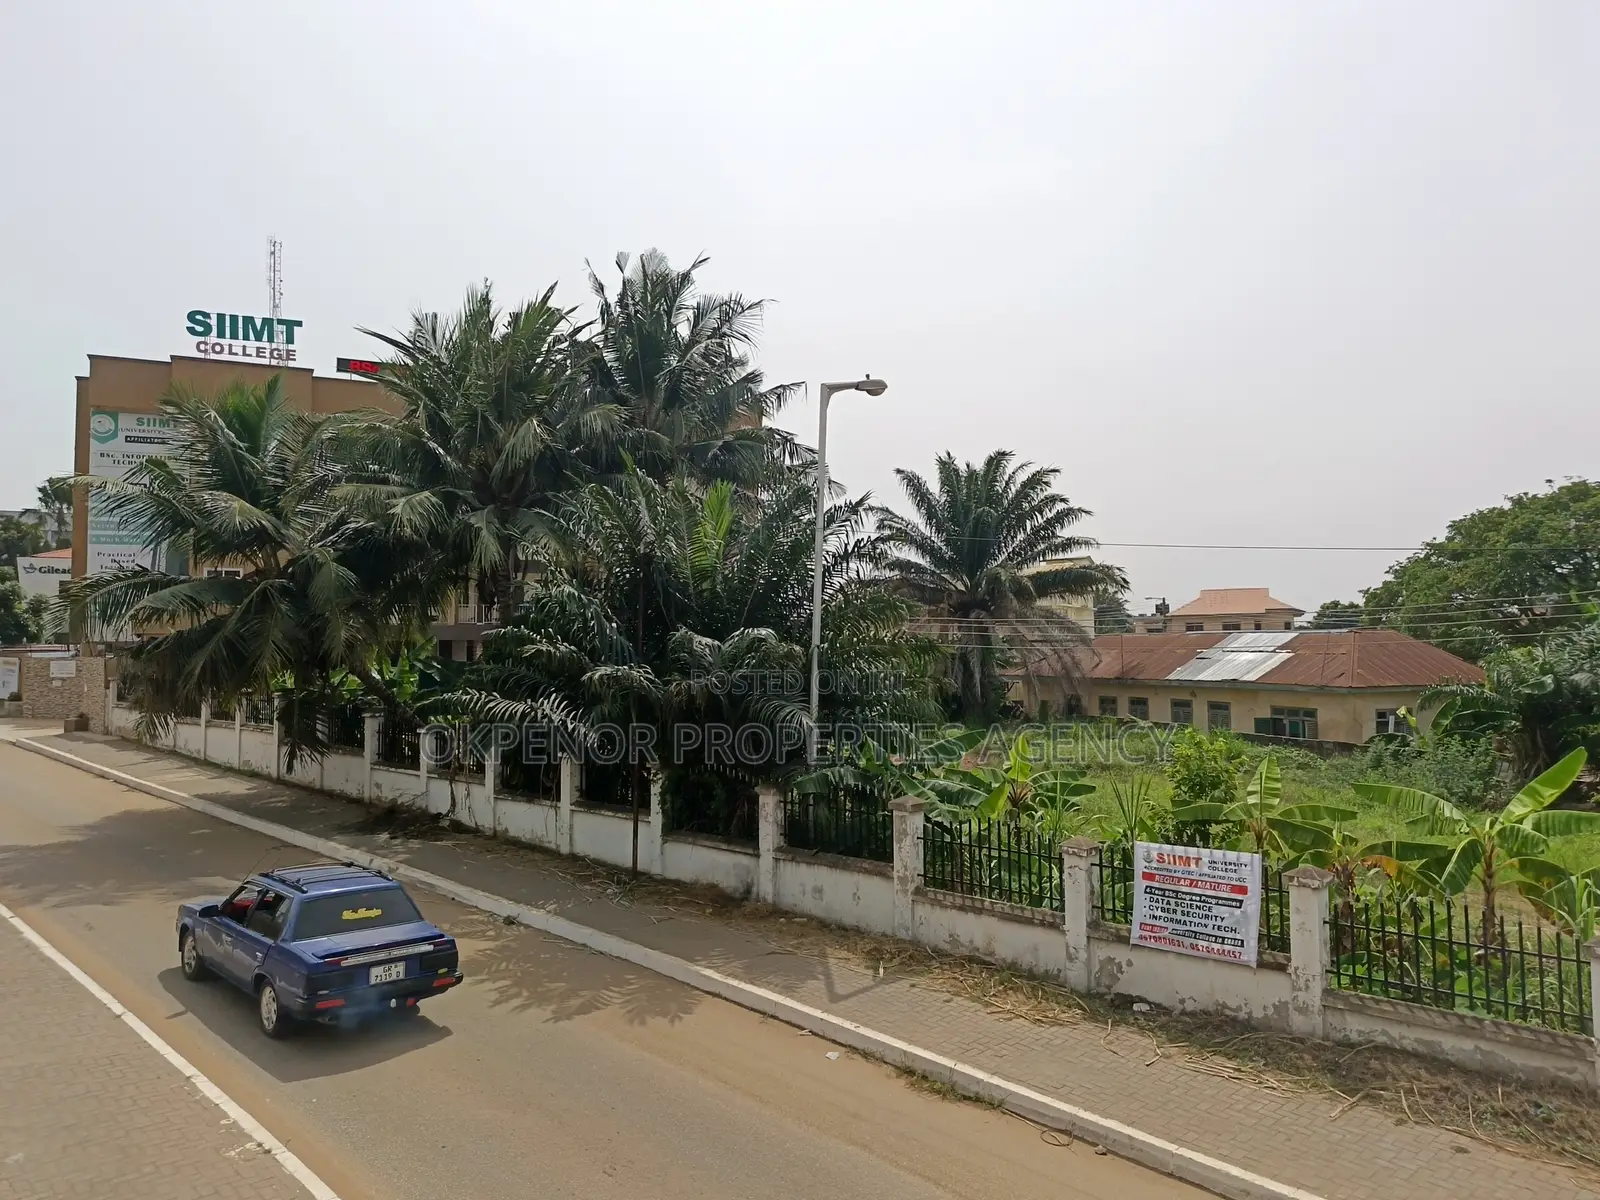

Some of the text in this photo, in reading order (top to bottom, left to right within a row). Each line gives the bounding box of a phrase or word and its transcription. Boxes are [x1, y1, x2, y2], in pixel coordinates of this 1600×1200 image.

[186, 310, 303, 345] SIIMT
[195, 340, 297, 362] COLLEGE
[1156, 852, 1203, 868] SIIMT
[1208, 859, 1248, 868] UNIVERSITY
[1144, 865, 1173, 874] ACCREDITED
[1198, 872, 1226, 881] AFFILIATED
[1207, 865, 1239, 874] COLLEGE
[1154, 874, 1190, 888] REGULAR
[1197, 880, 1233, 893] MATURE
[1149, 896, 1214, 913] DATA SCIENCE
[1165, 890, 1177, 898] BSc
[1178, 892, 1200, 903] Degree
[1201, 895, 1240, 907] Programmes
[1148, 904, 1226, 923] CYBER SECURITY
[1149, 913, 1240, 934] INFORMATION TECH.
